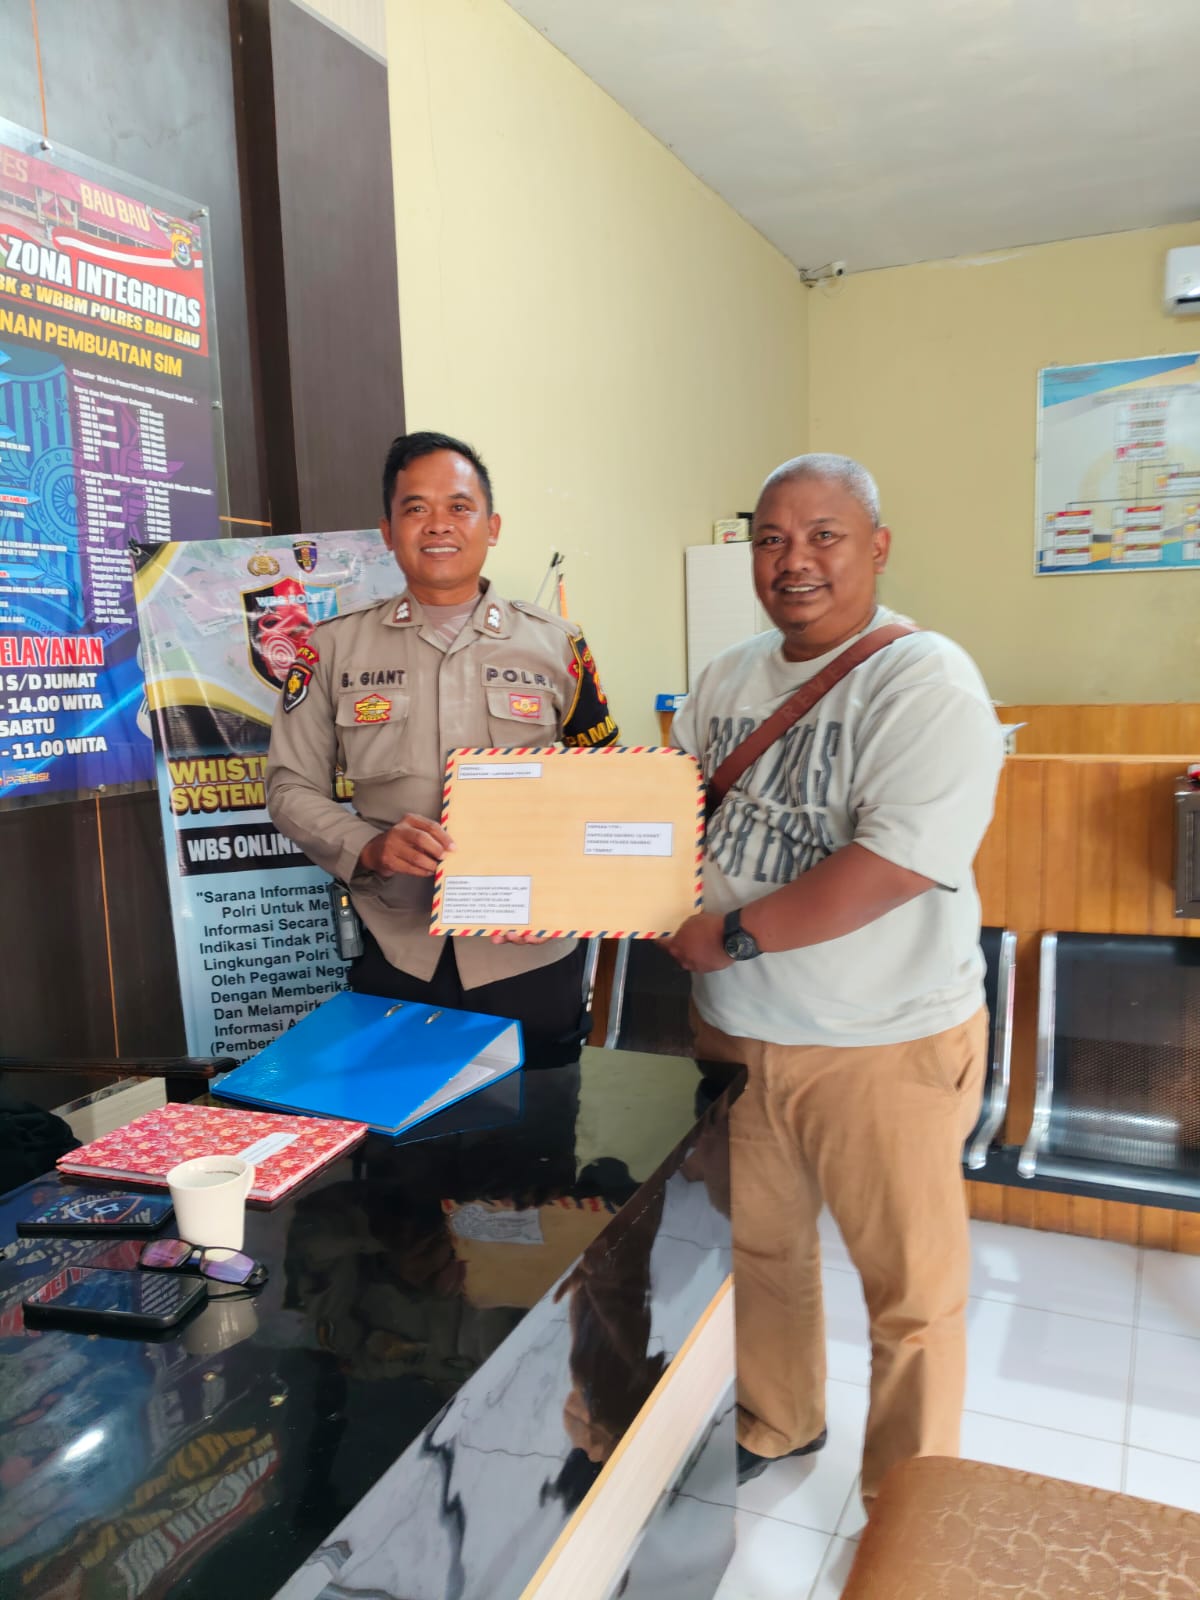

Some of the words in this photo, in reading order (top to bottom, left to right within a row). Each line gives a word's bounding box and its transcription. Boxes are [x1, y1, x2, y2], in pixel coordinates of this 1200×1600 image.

[80, 183, 115, 219] BAU
[116, 194, 151, 232] BAU
[6, 236, 73, 288] ZONA
[77, 259, 201, 328] INTEGRITAS
[20, 283, 33, 299] &
[36, 284, 88, 315] WBBM
[91, 301, 142, 332] POLRES
[145, 317, 173, 341] BAU
[174, 325, 200, 349] BAU
[45, 321, 152, 370] PEMBUATAN
[153, 353, 183, 377] SIM
[0, 636, 104, 666] ELAYANAN
[6, 673, 42, 691] S/D
[44, 673, 97, 689] JUMAT
[360, 670, 405, 685] GIANT
[8, 696, 59, 713] 14.00
[62, 694, 103, 711] WITA
[0, 718, 55, 737] SABTU
[12, 740, 64, 759] 11.00
[66, 737, 107, 754] WITA
[172, 782, 265, 811] SYSTEM
[187, 837, 231, 862] WBS
[260, 881, 330, 899] Informasi
[222, 904, 256, 918] Polri
[261, 899, 304, 916] Untuk
[309, 899, 330, 911] Me
[204, 920, 274, 937] Informasi
[278, 917, 328, 931] Secara
[199, 937, 257, 955] Indikasi
[262, 934, 311, 949] Tindak
[204, 953, 291, 972] Lingkungan
[296, 948, 329, 962] Polri
[212, 973, 246, 987] Oleh
[250, 967, 312, 985] Pegawai
[211, 989, 267, 1004] Dengan
[214, 1007, 243, 1020] Dan
[215, 1019, 284, 1037] Informasi
